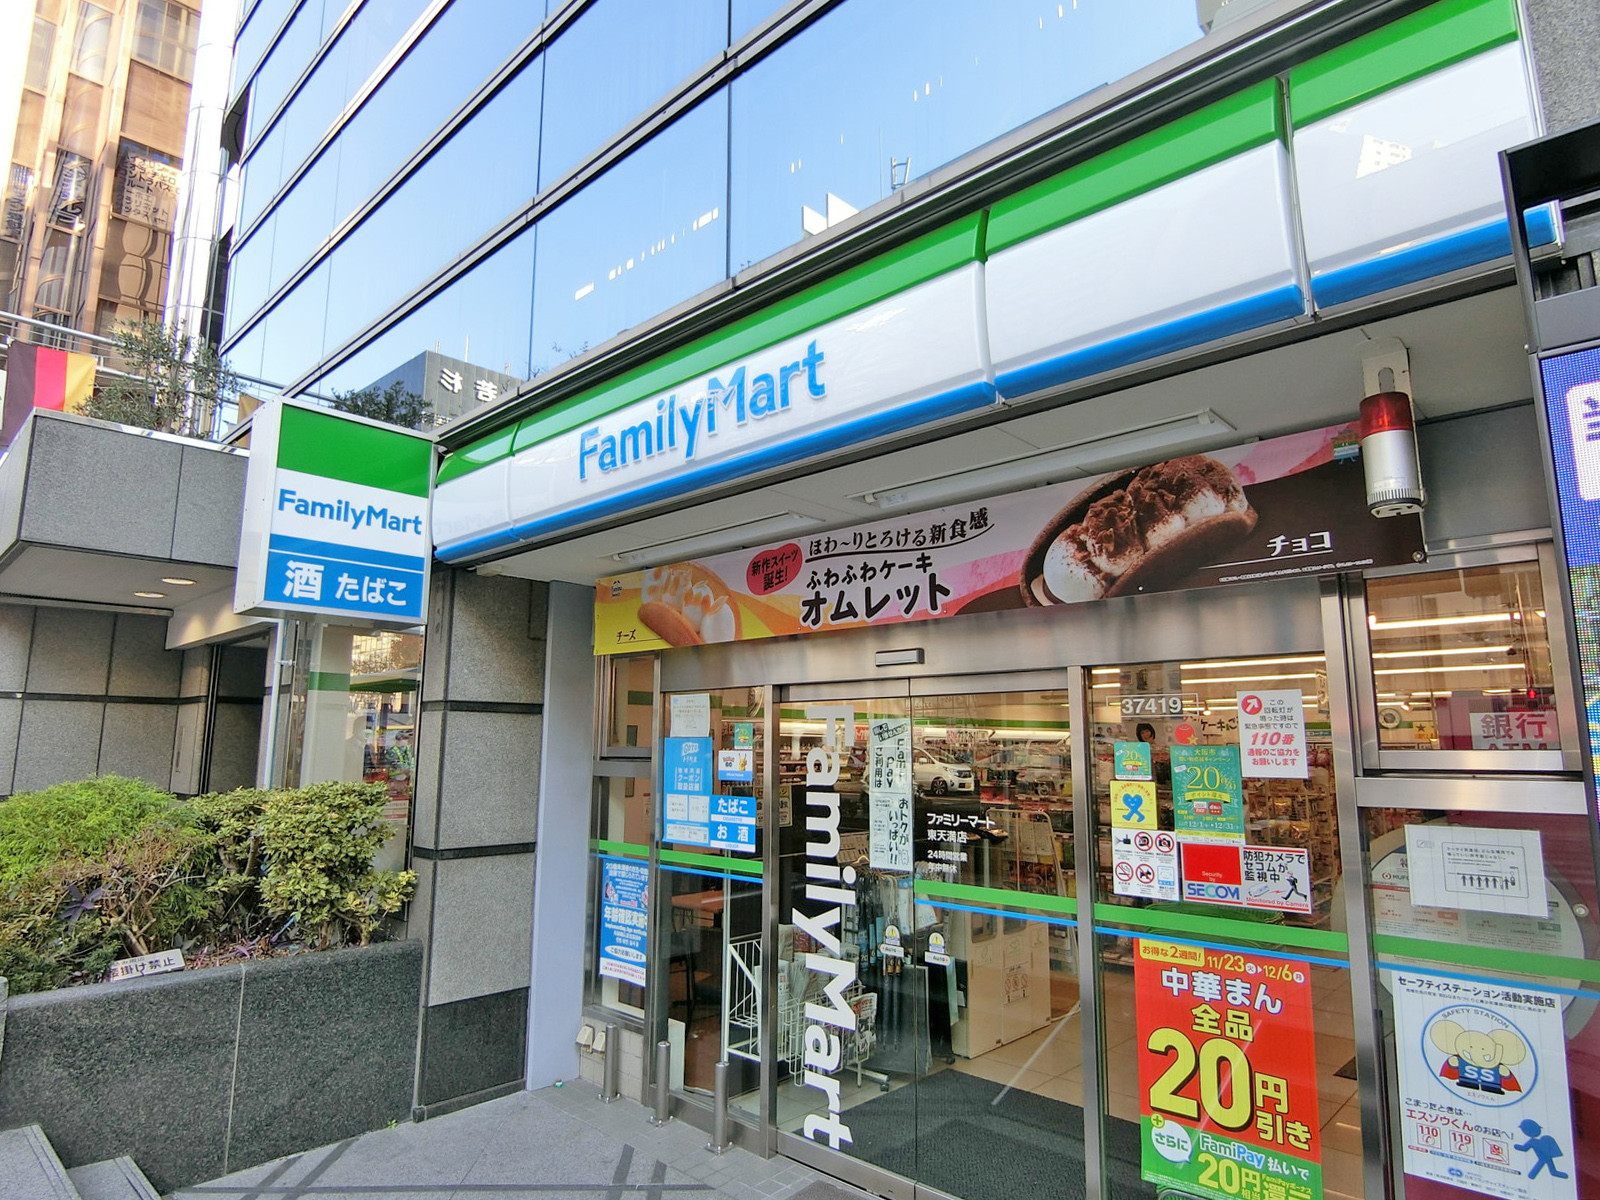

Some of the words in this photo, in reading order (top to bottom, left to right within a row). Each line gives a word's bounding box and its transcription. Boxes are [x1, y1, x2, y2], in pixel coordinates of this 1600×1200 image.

[579, 339, 827, 481] FamilyMart
[278, 488, 422, 536] FamilyMart
[1266, 530, 1332, 557] チョコ
[751, 549, 798, 577] 新作スイーツ
[806, 552, 933, 591] ふわふわケーキ
[283, 560, 325, 601] 酒
[335, 572, 407, 607] たばこ
[763, 565, 788, 592] 誕生!
[801, 572, 952, 627] オムレット
[616, 629, 637, 642] チーズ
[1121, 697, 1182, 715] 37419
[1263, 706, 1294, 714] 回転灯が
[1480, 712, 1548, 740] 銀行
[1251, 731, 1296, 746] 110番
[1247, 748, 1300, 757] 通報のご協力を
[1252, 757, 1297, 766] お願いします
[677, 774, 701, 782] クーポン
[875, 747, 884, 788] ご利用は
[718, 798, 749, 814] たばこ
[899, 798, 909, 846] おトクが
[926, 812, 996, 830] ファミリーマート
[927, 829, 969, 844] 東天満店
[927, 849, 968, 863] 24時間営業
[1243, 850, 1306, 865] 防犯カメラで
[928, 862, 958, 874] 年中無休
[1202, 870, 1222, 879] Security
[1244, 861, 1289, 874] セコムが
[1244, 871, 1280, 883] 監視中
[1187, 883, 1240, 900] SECOM
[1246, 896, 1275, 906] Monitored
[1285, 900, 1309, 908] Camera
[792, 704, 857, 1151] FamilyMart
[1142, 945, 1202, 962] お得な2週間!
[1207, 953, 1245, 973] 11/23
[1263, 964, 1293, 981] 12/6
[1161, 967, 1283, 1014] 中華まん
[1398, 975, 1556, 1009] セーフティステーション活動実施店
[1191, 1003, 1254, 1043] 全品
[1441, 1007, 1471, 1019] SAFETY
[1473, 1009, 1510, 1029] STATION
[1147, 1027, 1254, 1132] 20
[1464, 1064, 1495, 1083] SS
[1254, 1071, 1289, 1115] 円
[1255, 1109, 1313, 1152] 引き
[1406, 1108, 1514, 1141] エスゾウくんのお店へ!
[1419, 1125, 1439, 1138] 110
[1154, 1131, 1189, 1152] さらに
[1451, 1132, 1472, 1145] 119
[1200, 1134, 1266, 1170] FamiPay
[1267, 1156, 1310, 1181] 払いで
